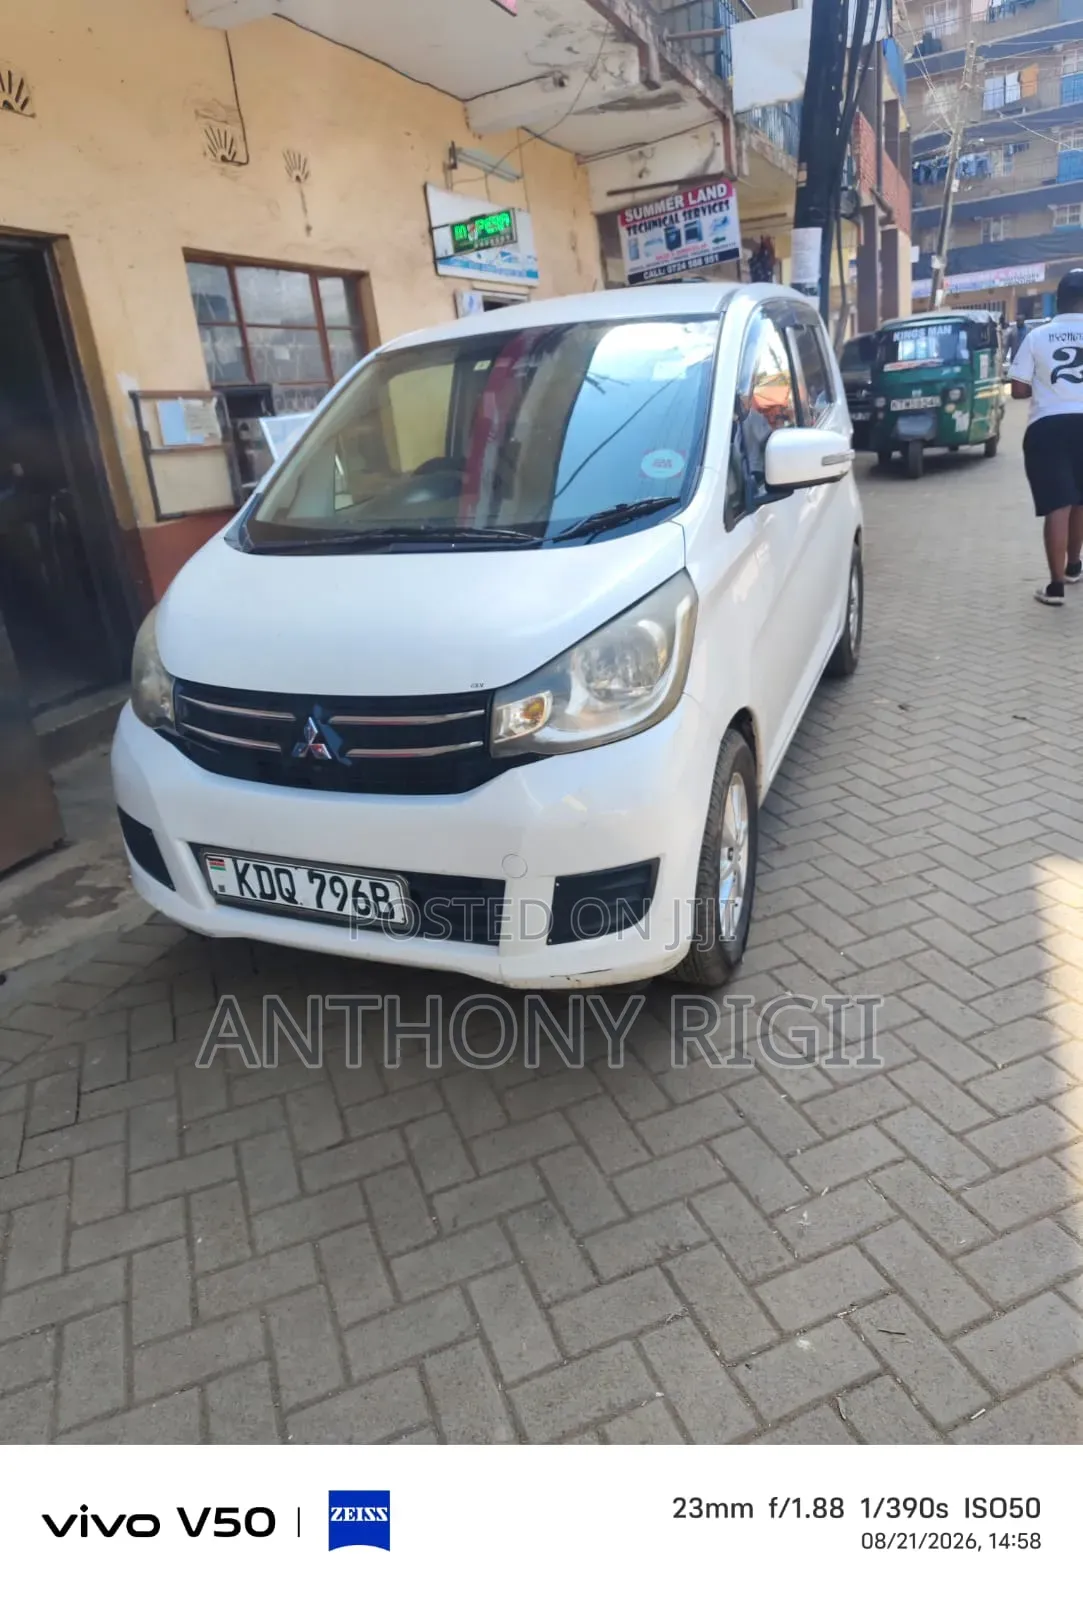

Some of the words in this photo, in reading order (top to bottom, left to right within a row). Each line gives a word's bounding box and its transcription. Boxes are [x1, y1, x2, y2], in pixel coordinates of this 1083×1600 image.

[624, 195, 684, 222] SUMMER
[688, 183, 727, 205] LAND
[626, 213, 680, 237] TECHNICAL
[682, 199, 730, 221] SERVICES
[643, 266, 666, 280] CALL:
[893, 328, 926, 342] KINGS
[928, 324, 952, 337] MAN
[232, 858, 302, 905] KDQ
[308, 870, 395, 920] 796B
